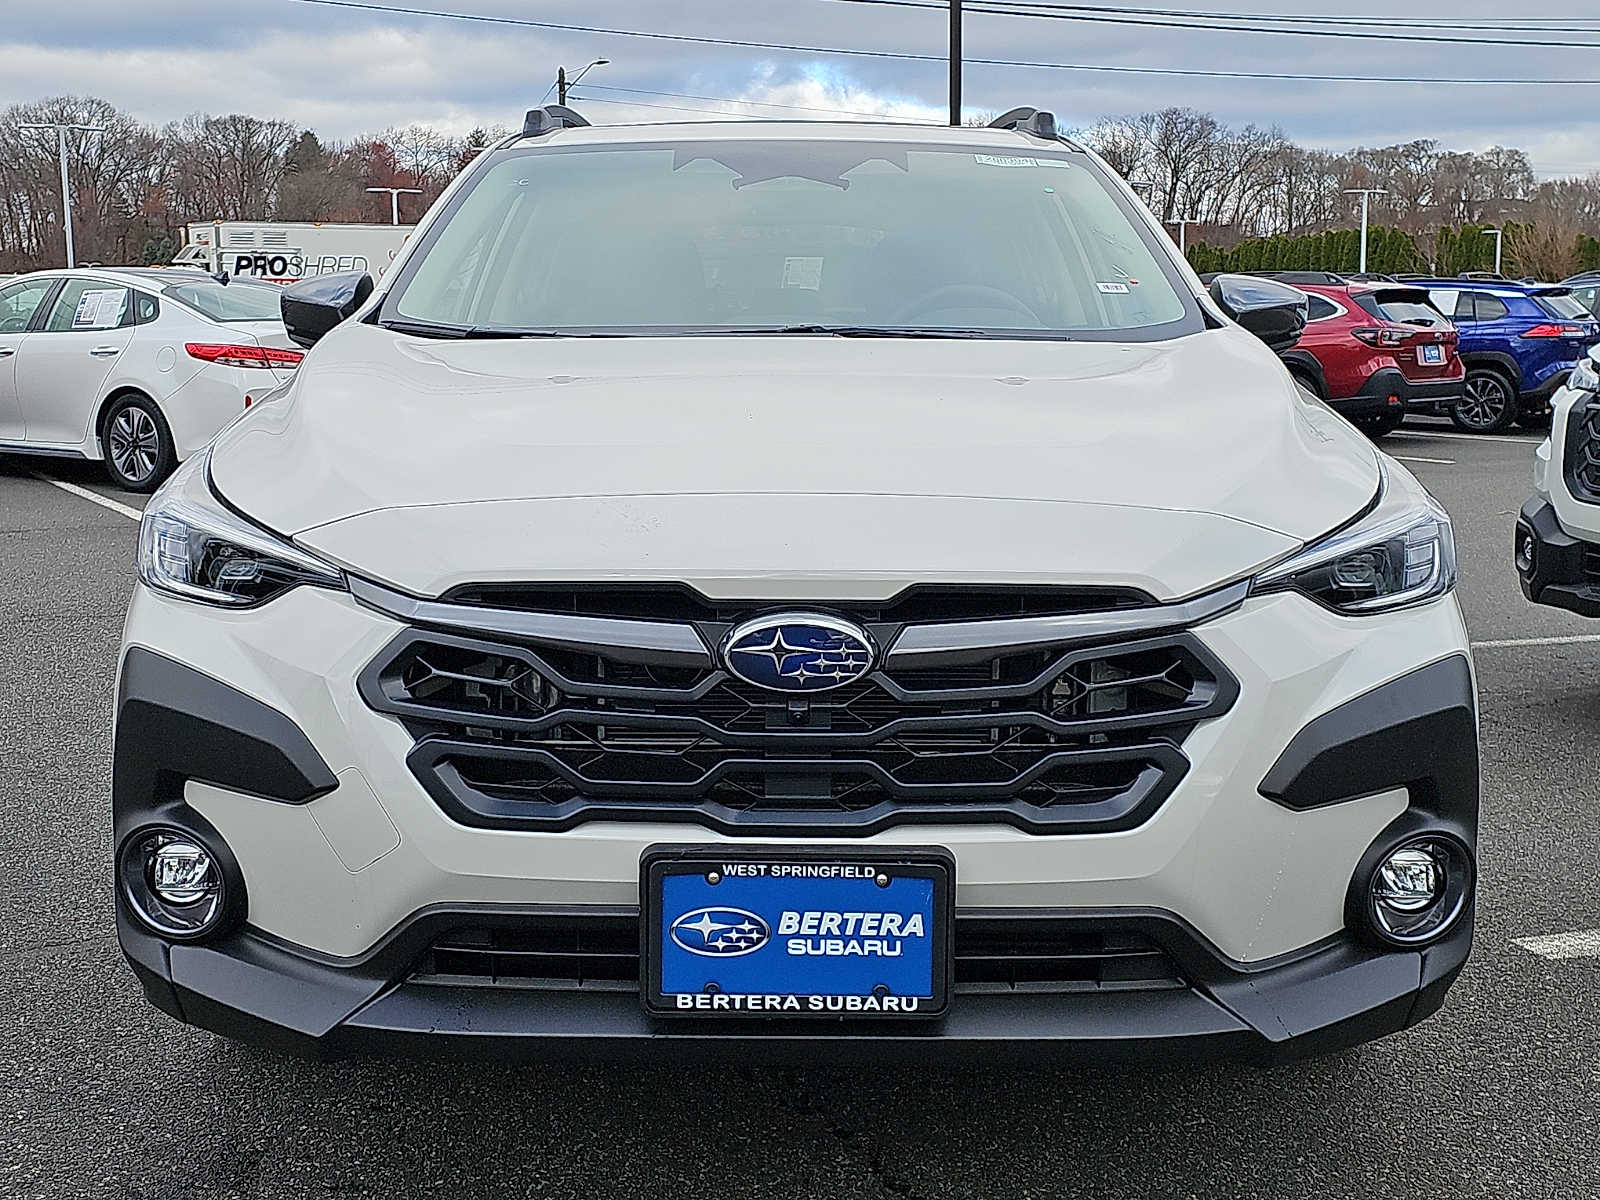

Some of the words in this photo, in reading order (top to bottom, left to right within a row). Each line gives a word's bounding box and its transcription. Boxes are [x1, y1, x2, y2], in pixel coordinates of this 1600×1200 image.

[234, 255, 368, 277] PROSHRED
[722, 864, 767, 877] WEST
[771, 865, 875, 878] SPRINGFIELD
[778, 911, 924, 937] BERTERA
[787, 939, 902, 956] SUBARU
[676, 993, 801, 1010] BERTERA
[808, 995, 919, 1012] SUBARU
